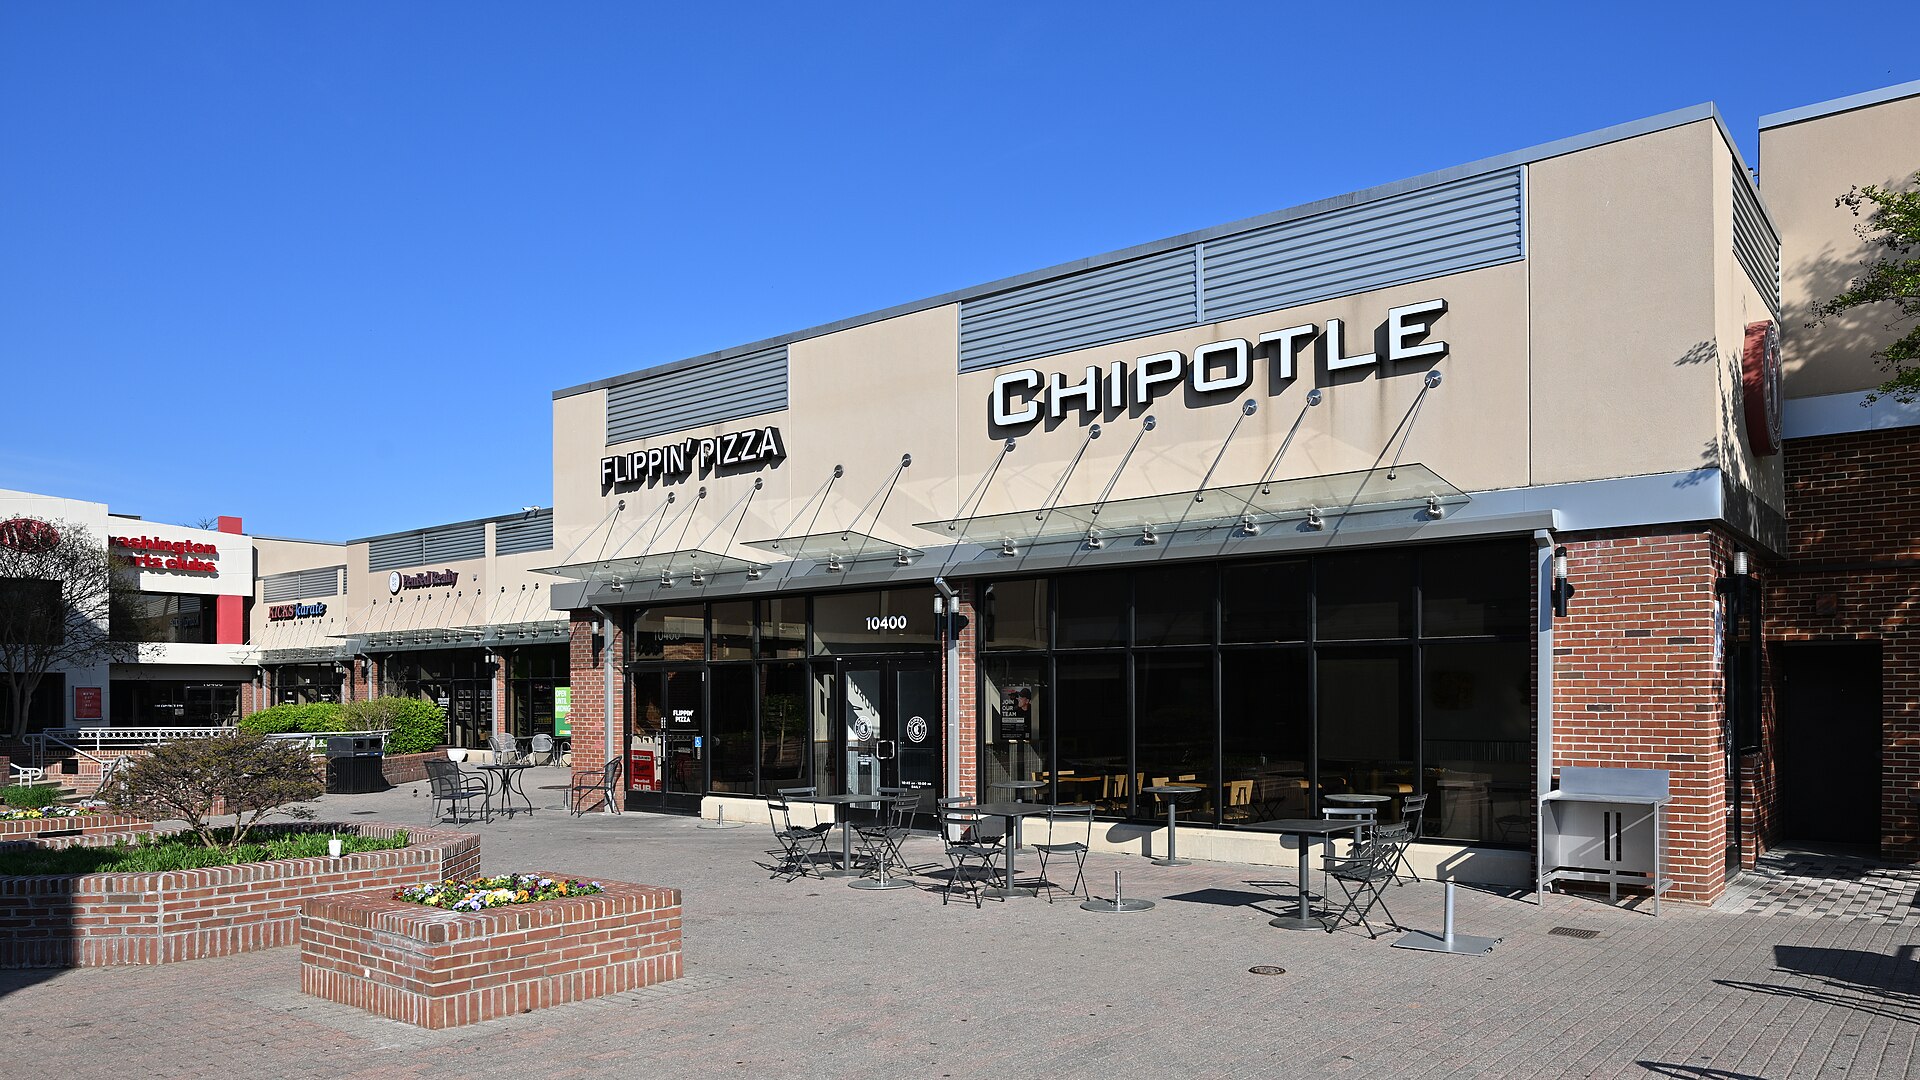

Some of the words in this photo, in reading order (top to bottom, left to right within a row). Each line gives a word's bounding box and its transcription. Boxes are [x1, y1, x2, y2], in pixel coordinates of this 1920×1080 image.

[993, 298, 1448, 427] CHIPOTLE
[601, 437, 692, 485] FLIPPIN'
[699, 427, 781, 469] PIZZA
[165, 553, 217, 573] clubs
[268, 604, 295, 618] KICKS
[295, 603, 325, 616] karate
[865, 615, 907, 630] 10400
